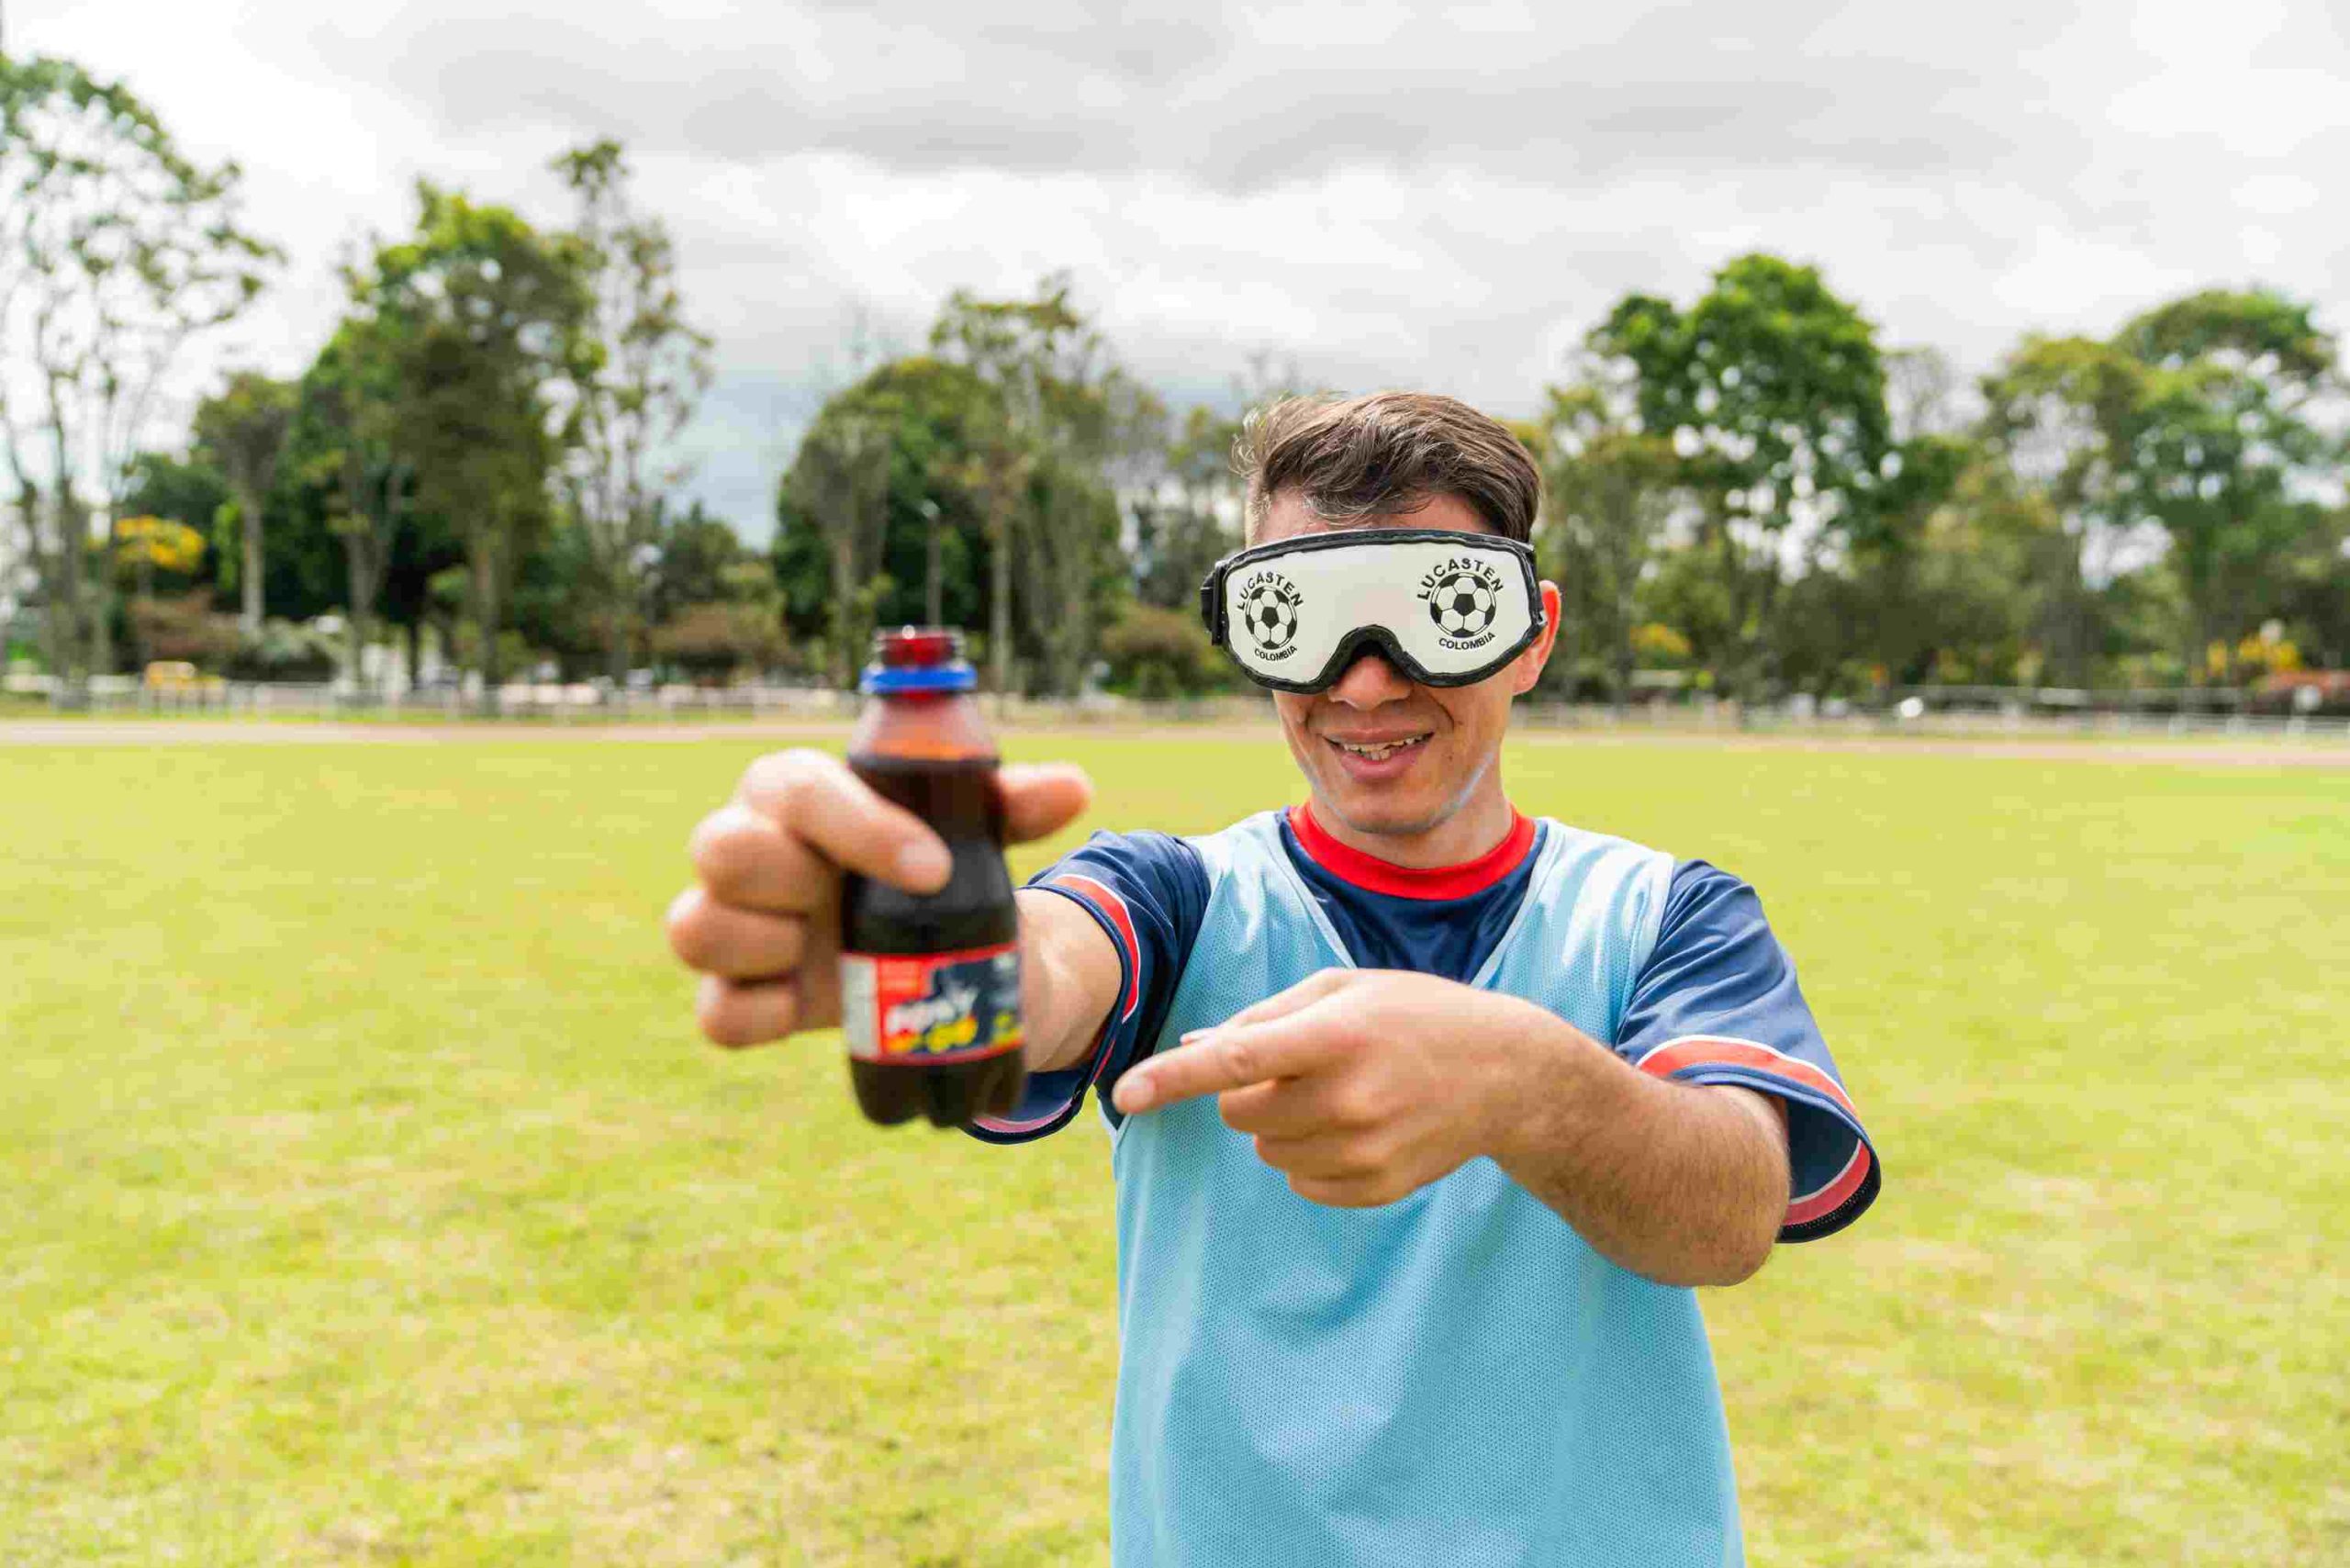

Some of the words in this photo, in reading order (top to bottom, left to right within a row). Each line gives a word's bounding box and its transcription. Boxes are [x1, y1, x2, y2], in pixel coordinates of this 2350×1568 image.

[1237, 571, 1304, 610] LUCASTEN
[1416, 557, 1504, 600] LUCASTEN
[1254, 644, 1297, 661] COLOMBIA
[1438, 632, 1495, 650] COLOMBIA
